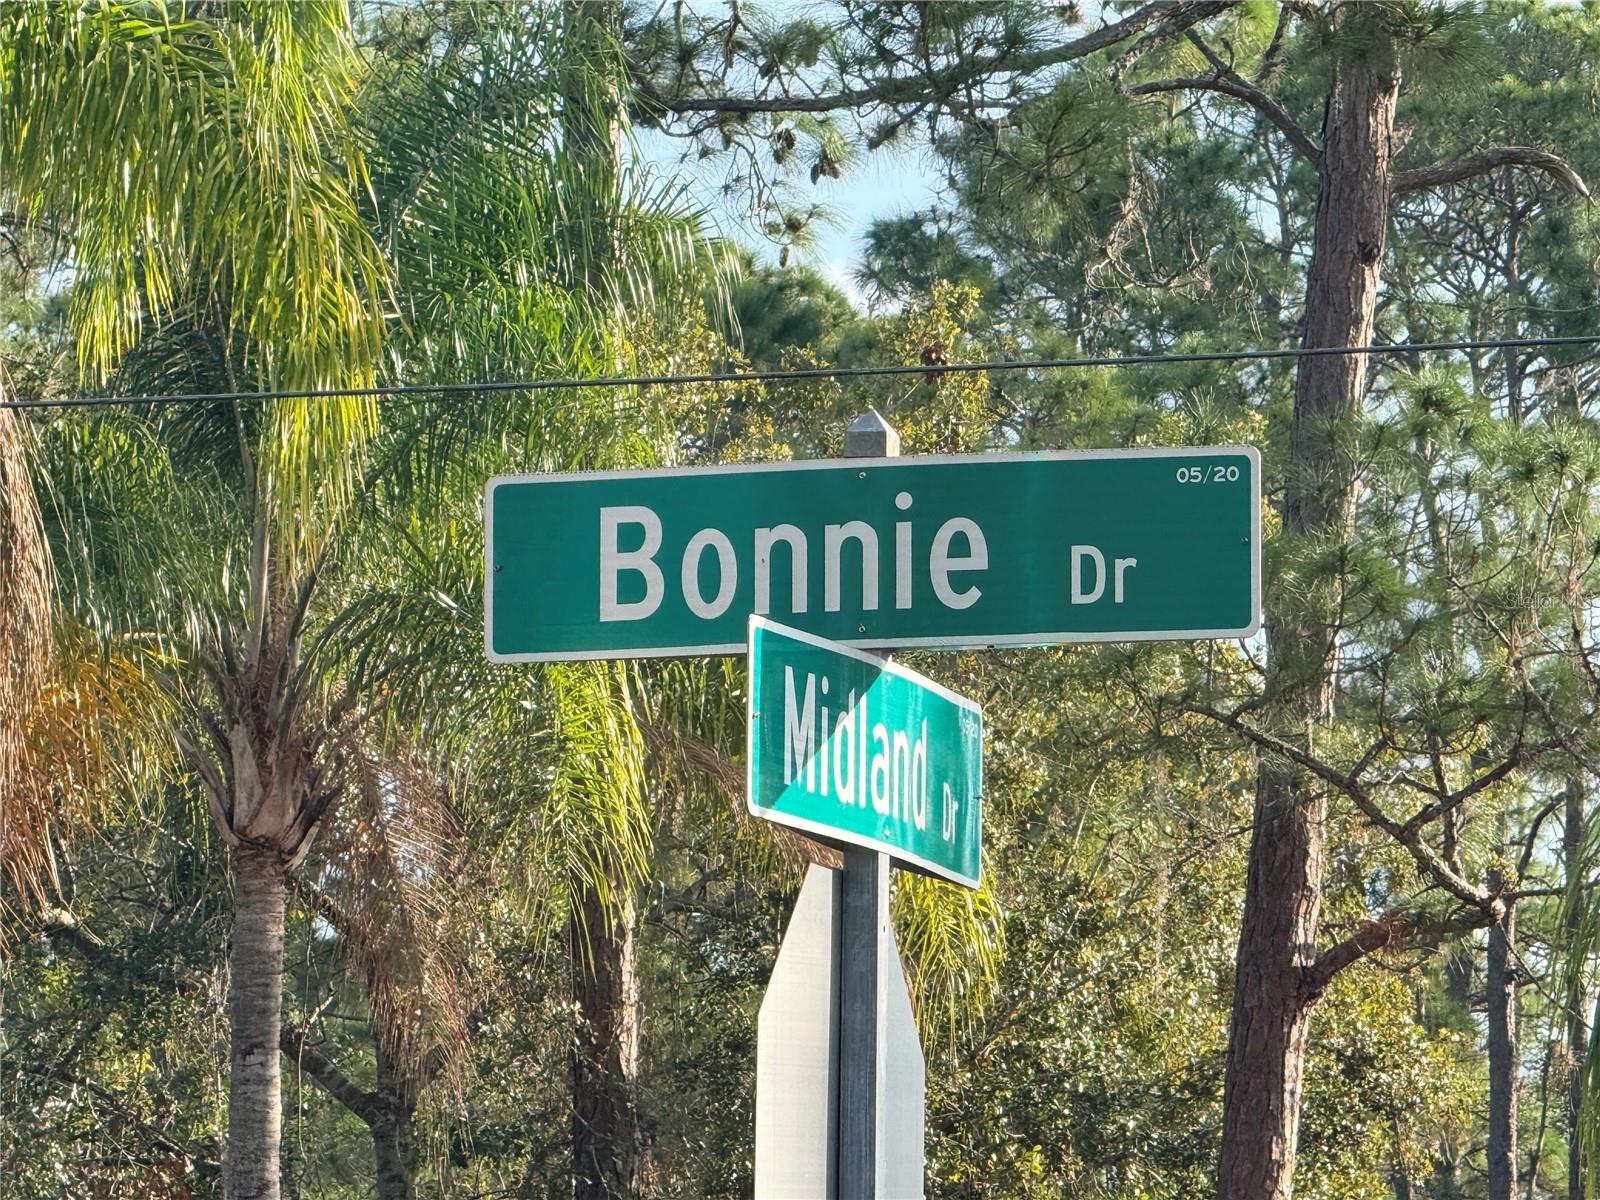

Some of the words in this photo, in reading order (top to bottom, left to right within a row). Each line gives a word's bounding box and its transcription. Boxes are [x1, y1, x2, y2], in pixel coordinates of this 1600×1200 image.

[1176, 465, 1240, 484] 05/20
[599, 492, 989, 622] Bonnie
[1070, 545, 1137, 606] Dr
[783, 665, 928, 831] Midland
[942, 782, 959, 845] Dr
